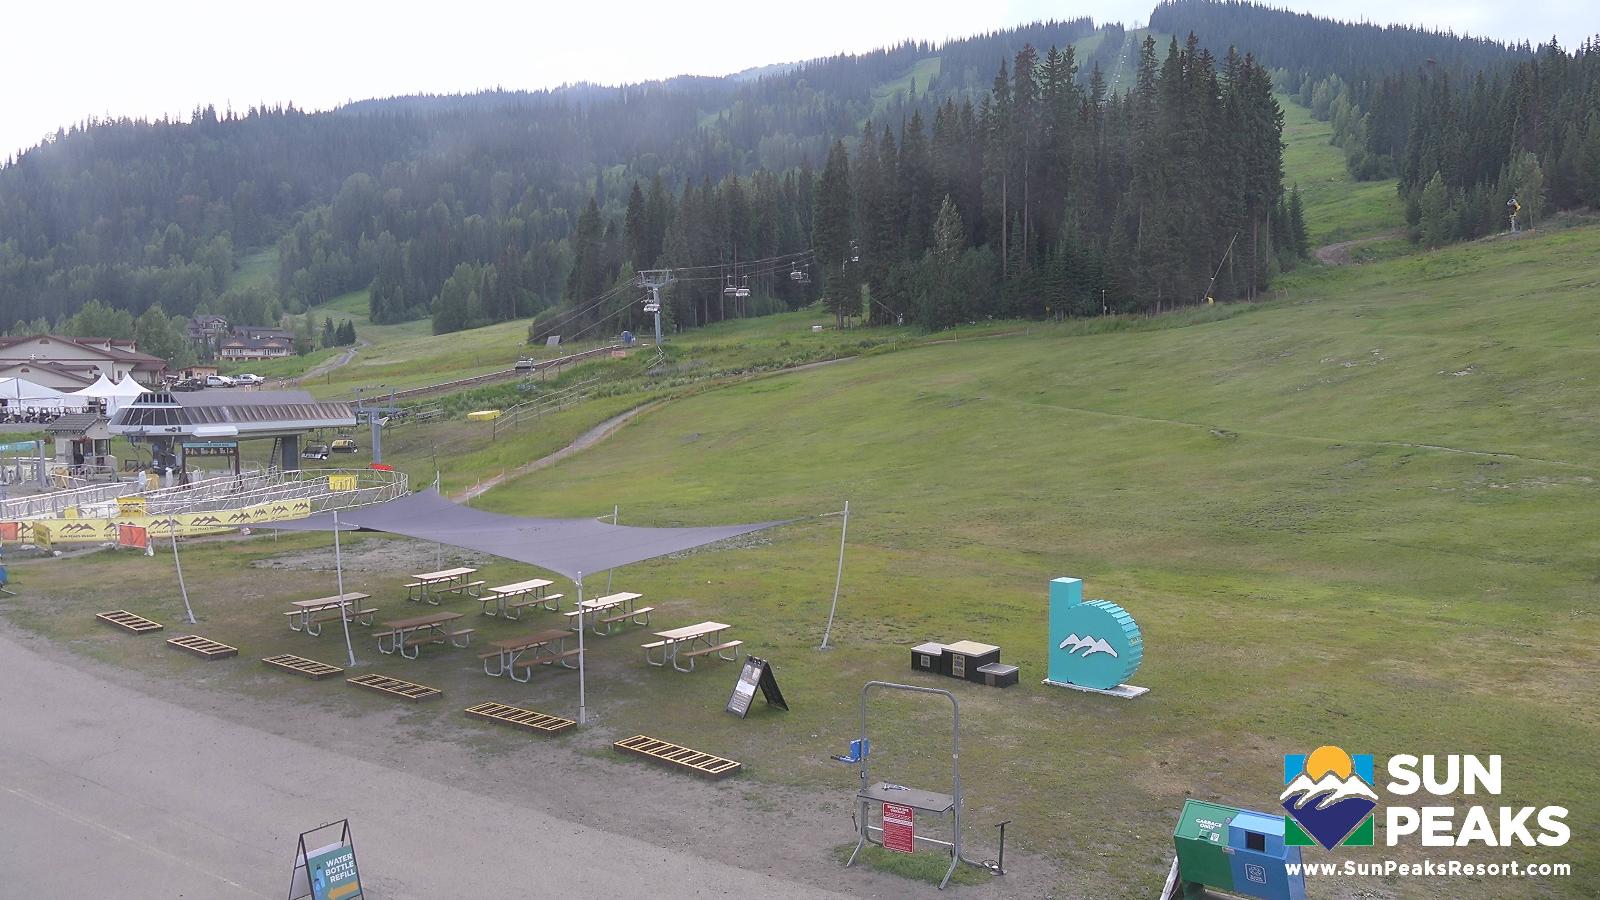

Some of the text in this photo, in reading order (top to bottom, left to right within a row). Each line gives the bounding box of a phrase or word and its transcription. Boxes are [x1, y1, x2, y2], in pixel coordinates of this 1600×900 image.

[1196, 818, 1222, 828] GARBAGE
[325, 853, 353, 868] WATER
[325, 860, 355, 876] BOTTLE
[330, 869, 356, 883] REFILL
